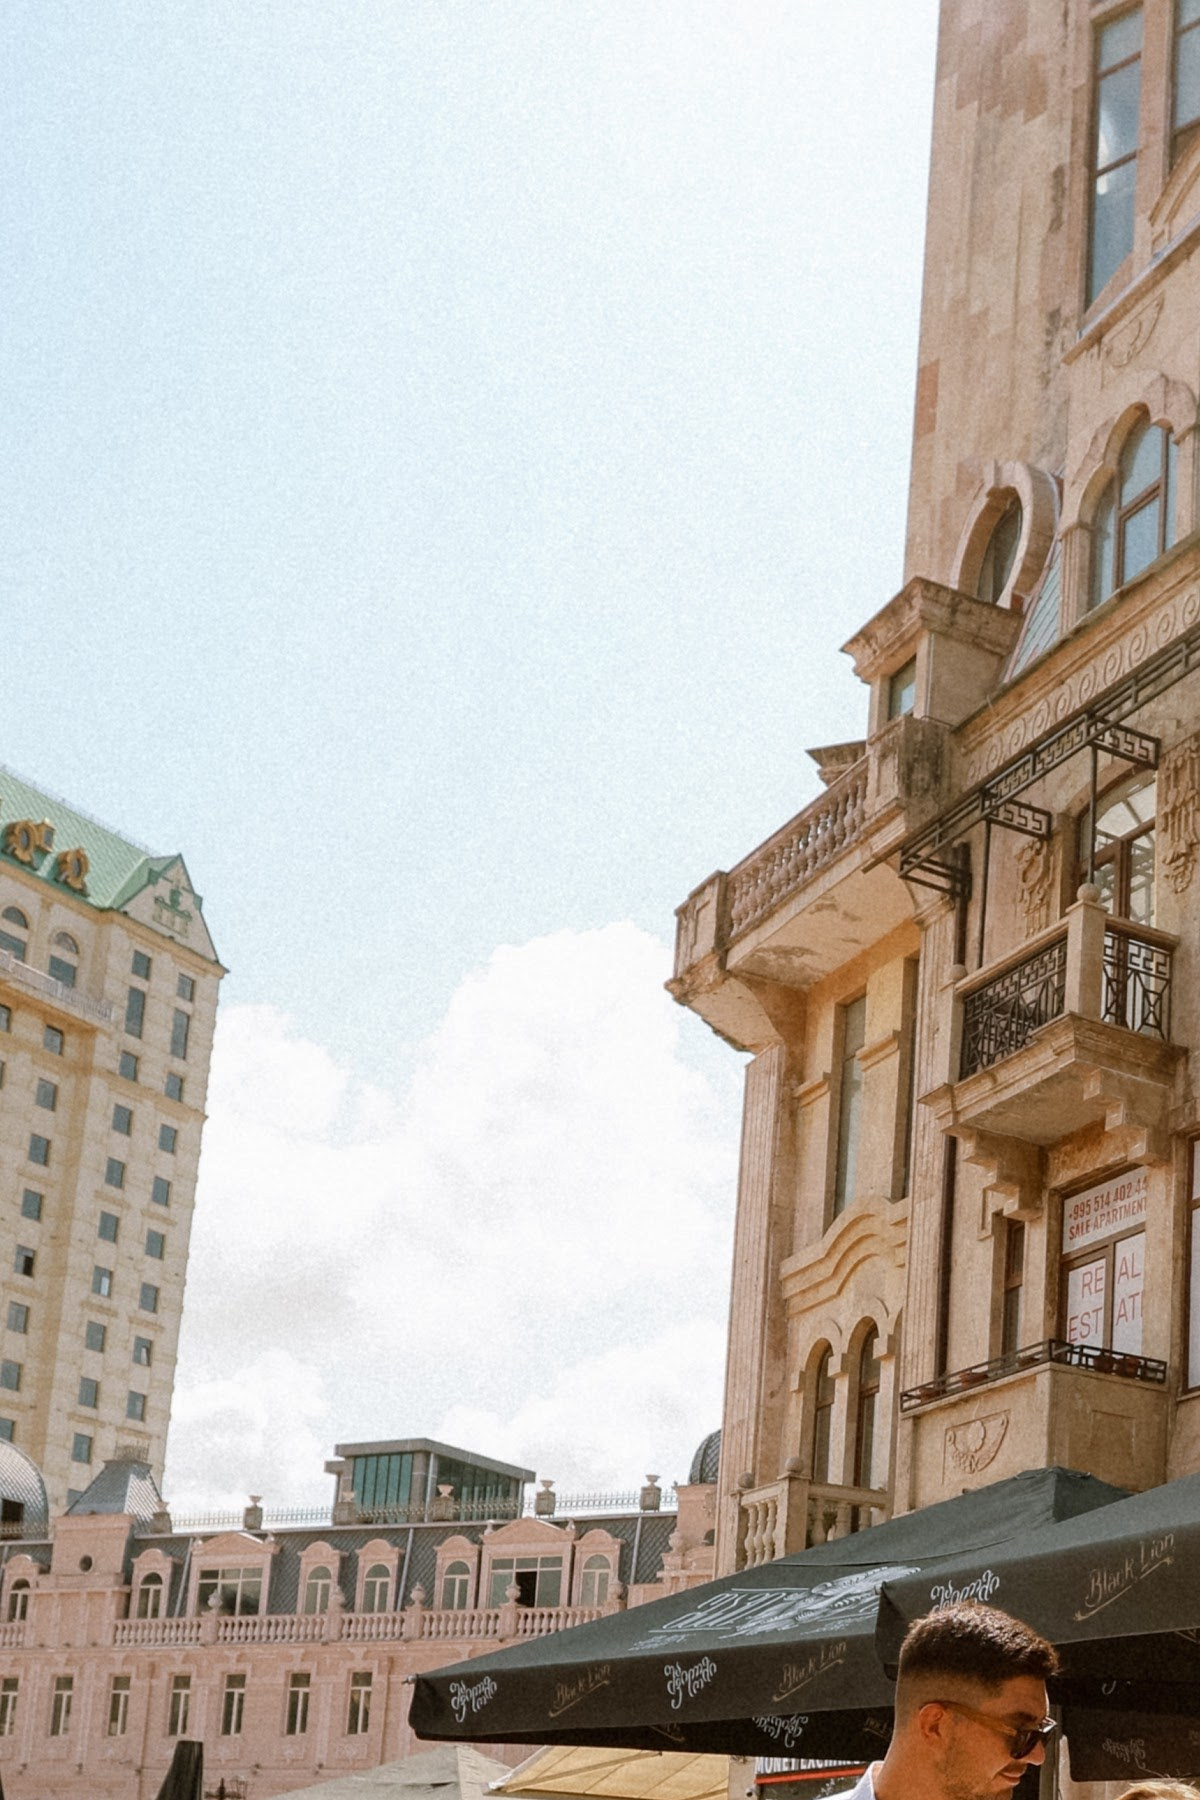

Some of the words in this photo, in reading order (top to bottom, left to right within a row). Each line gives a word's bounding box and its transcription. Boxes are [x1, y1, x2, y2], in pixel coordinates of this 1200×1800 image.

[1094, 1192, 1111, 1213] 514
[1113, 1182, 1133, 1203] 402
[1069, 1219, 1091, 1241] SALE
[1085, 1561, 1135, 1607] Black
[1139, 1533, 1174, 1570] Lion
